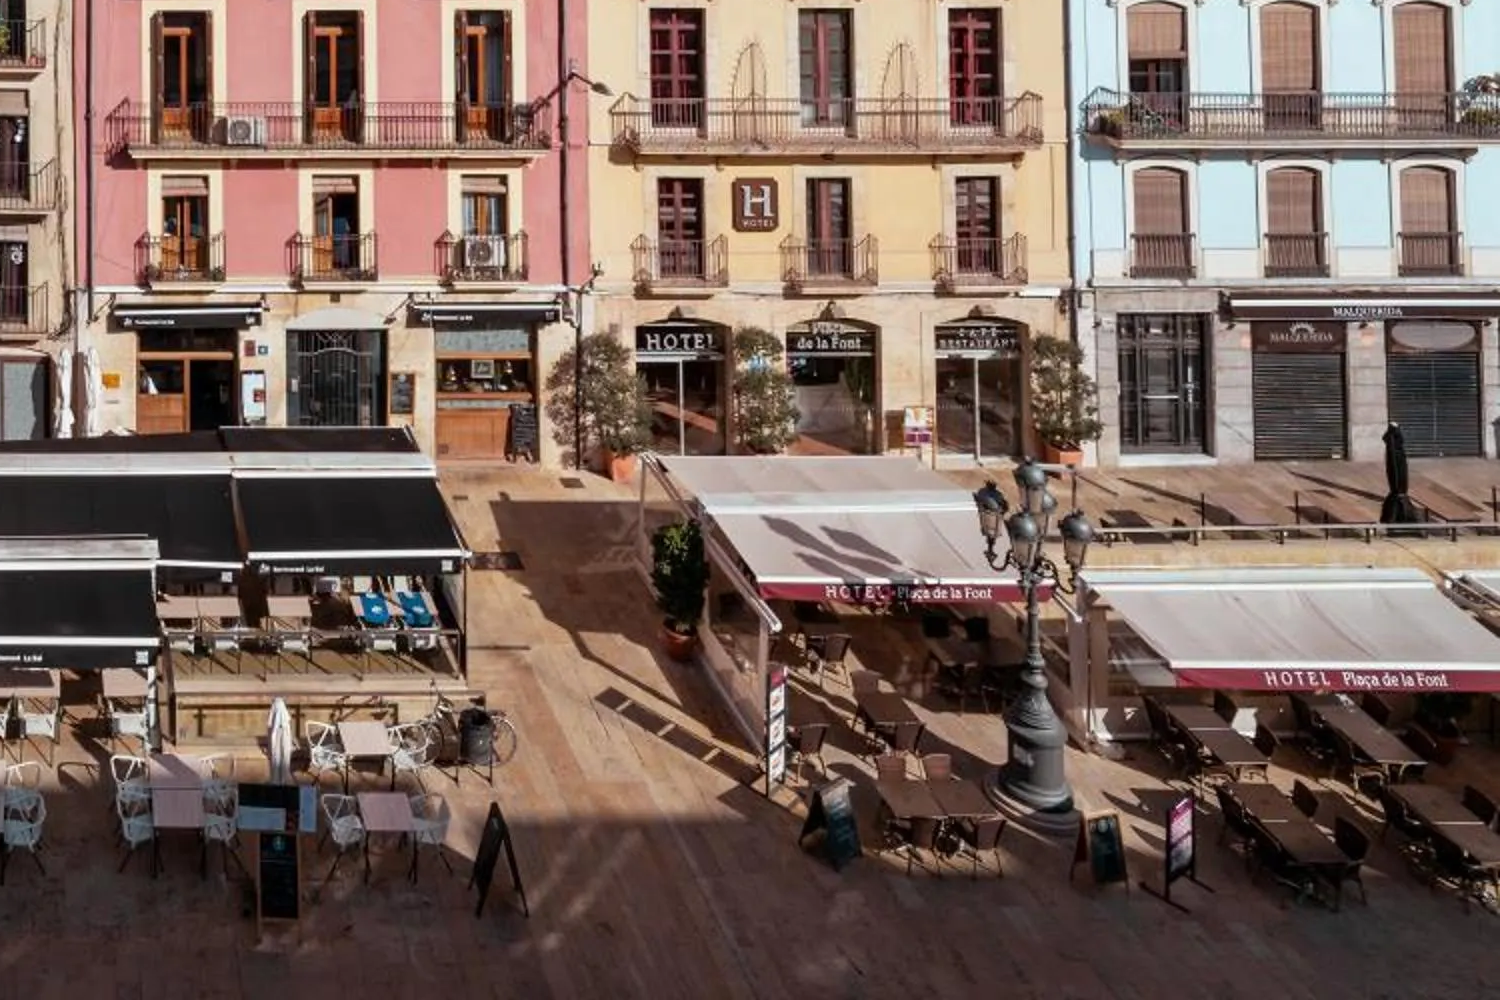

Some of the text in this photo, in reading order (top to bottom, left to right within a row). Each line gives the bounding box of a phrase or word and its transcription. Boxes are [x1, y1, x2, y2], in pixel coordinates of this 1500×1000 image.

[741, 184, 775, 217] H
[741, 219, 775, 228] HOTEL
[645, 333, 716, 350] HOTEL
[797, 336, 861, 349] de la Font
[825, 585, 993, 601] HOTEL Plaça de la Font
[1264, 671, 1449, 688] HOTEL Plaça de la Font
